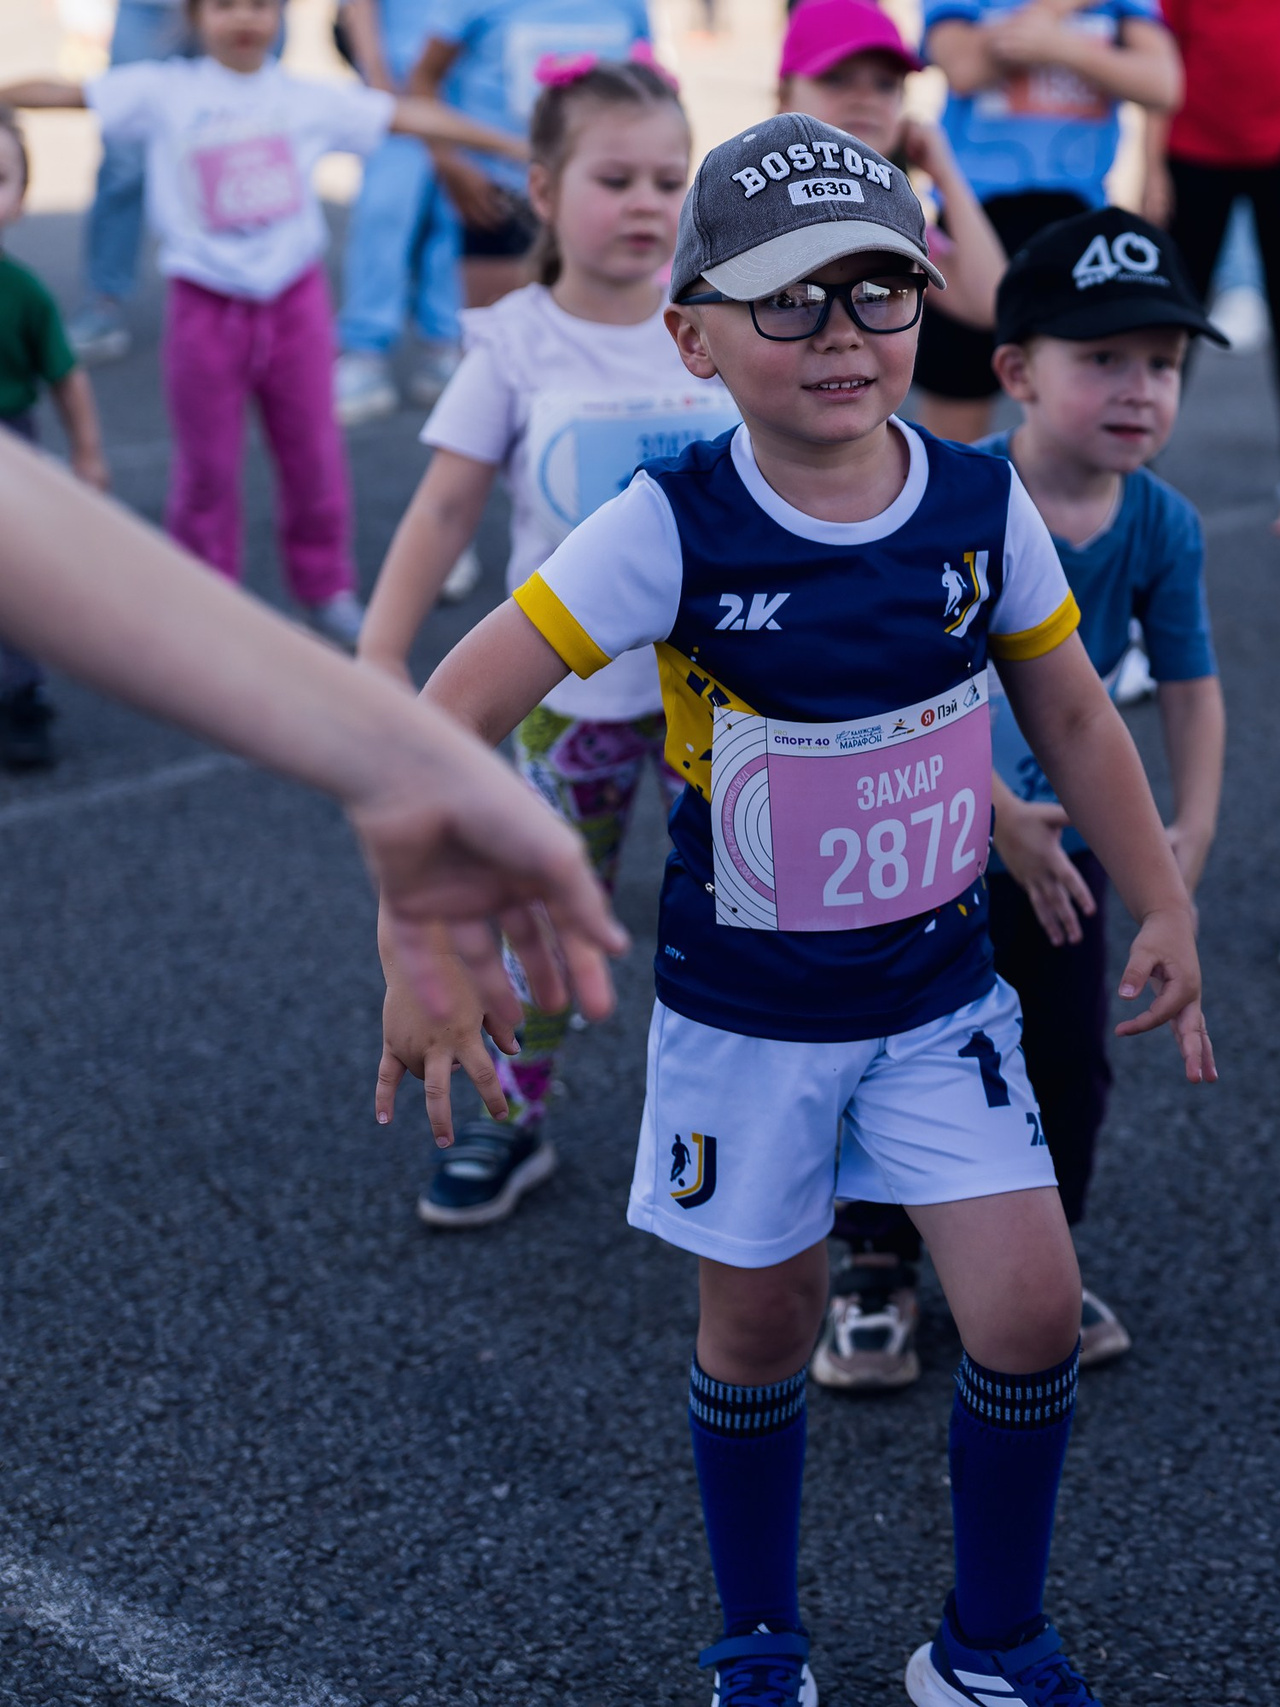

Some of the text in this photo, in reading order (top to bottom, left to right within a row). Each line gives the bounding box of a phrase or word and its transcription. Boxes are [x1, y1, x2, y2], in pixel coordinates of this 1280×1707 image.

[731, 141, 893, 199] BOSTON
[801, 182, 850, 199] 1630
[1072, 231, 1160, 280] 40
[714, 593, 791, 630] 2K
[937, 698, 958, 720] Пэй
[774, 735, 830, 746] СПОРТ 40
[839, 734, 882, 750] МАРАФОН
[856, 754, 944, 811] ЗАХАР
[819, 787, 976, 907] 2872
